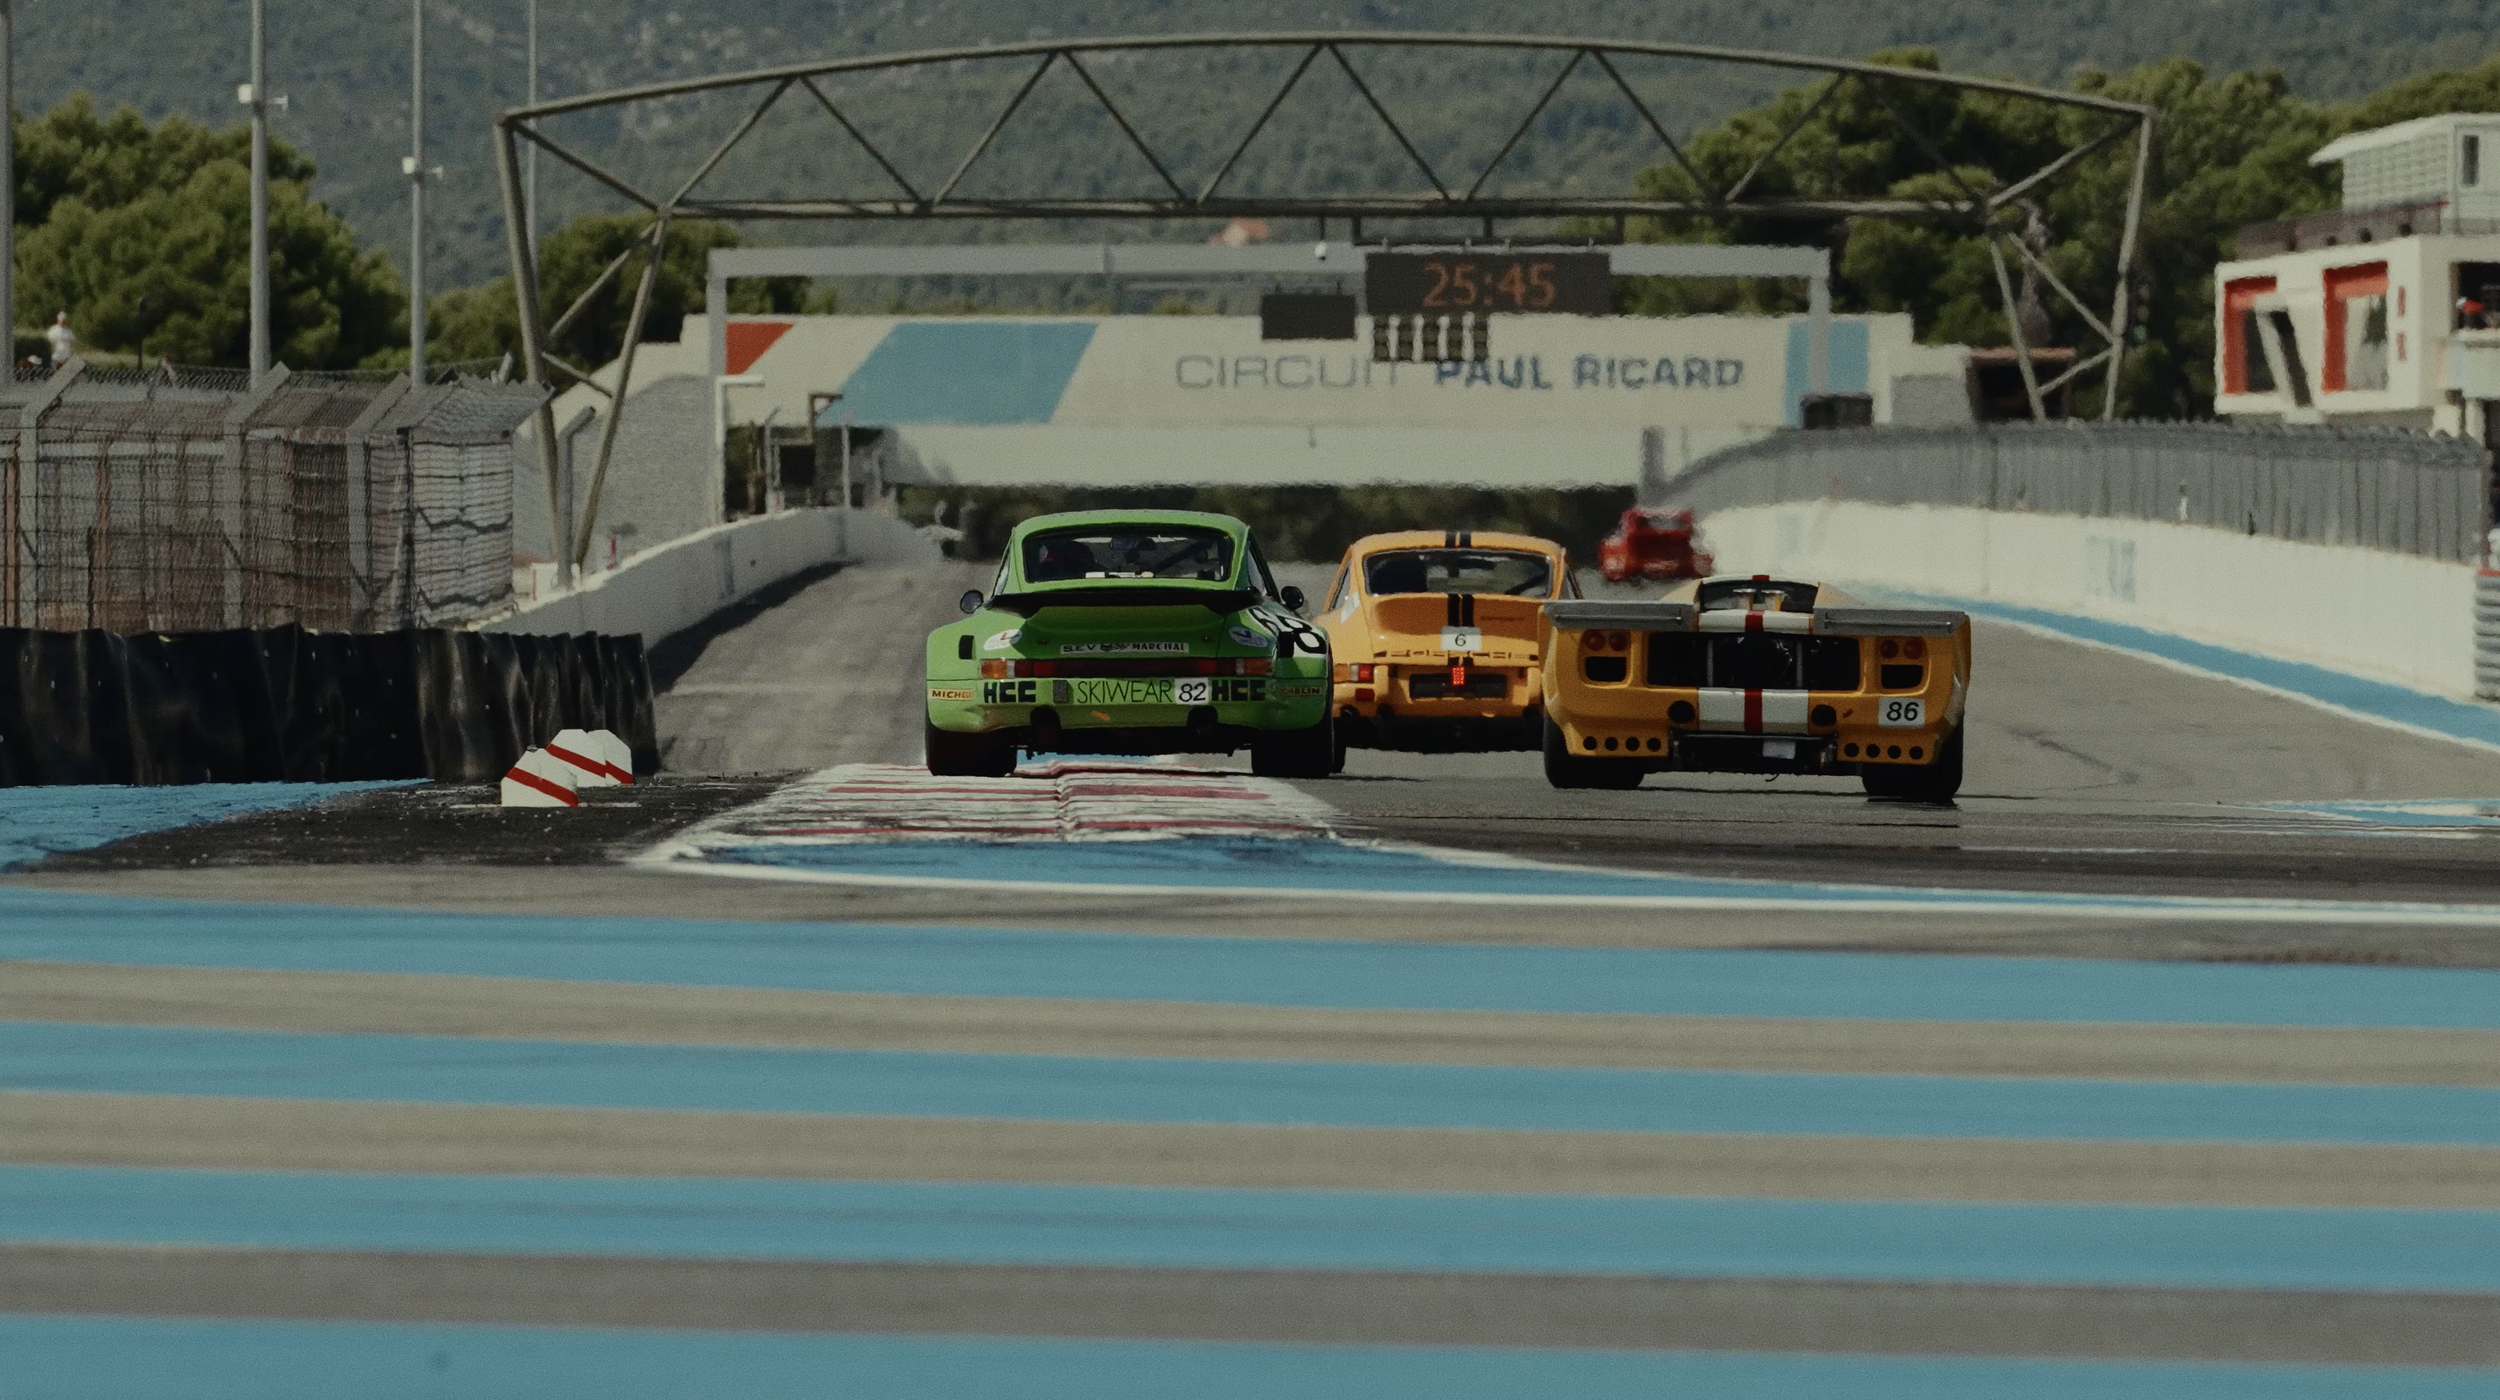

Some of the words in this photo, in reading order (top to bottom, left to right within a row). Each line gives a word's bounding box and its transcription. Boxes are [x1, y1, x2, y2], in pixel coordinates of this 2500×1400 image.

[1422, 261, 1556, 307] 25:45
[1434, 357, 1552, 390] PAUL
[1574, 354, 1744, 390] RICARD
[1062, 643, 1098, 653] SEV
[1131, 642, 1186, 651] MARCHAL
[1454, 633, 1467, 647] 6
[983, 681, 1037, 703] HCC
[1077, 680, 1173, 703] SKIWEAR
[1178, 682, 1207, 702] 82
[1211, 679, 1266, 702] HCC
[1886, 701, 1920, 722] 86
